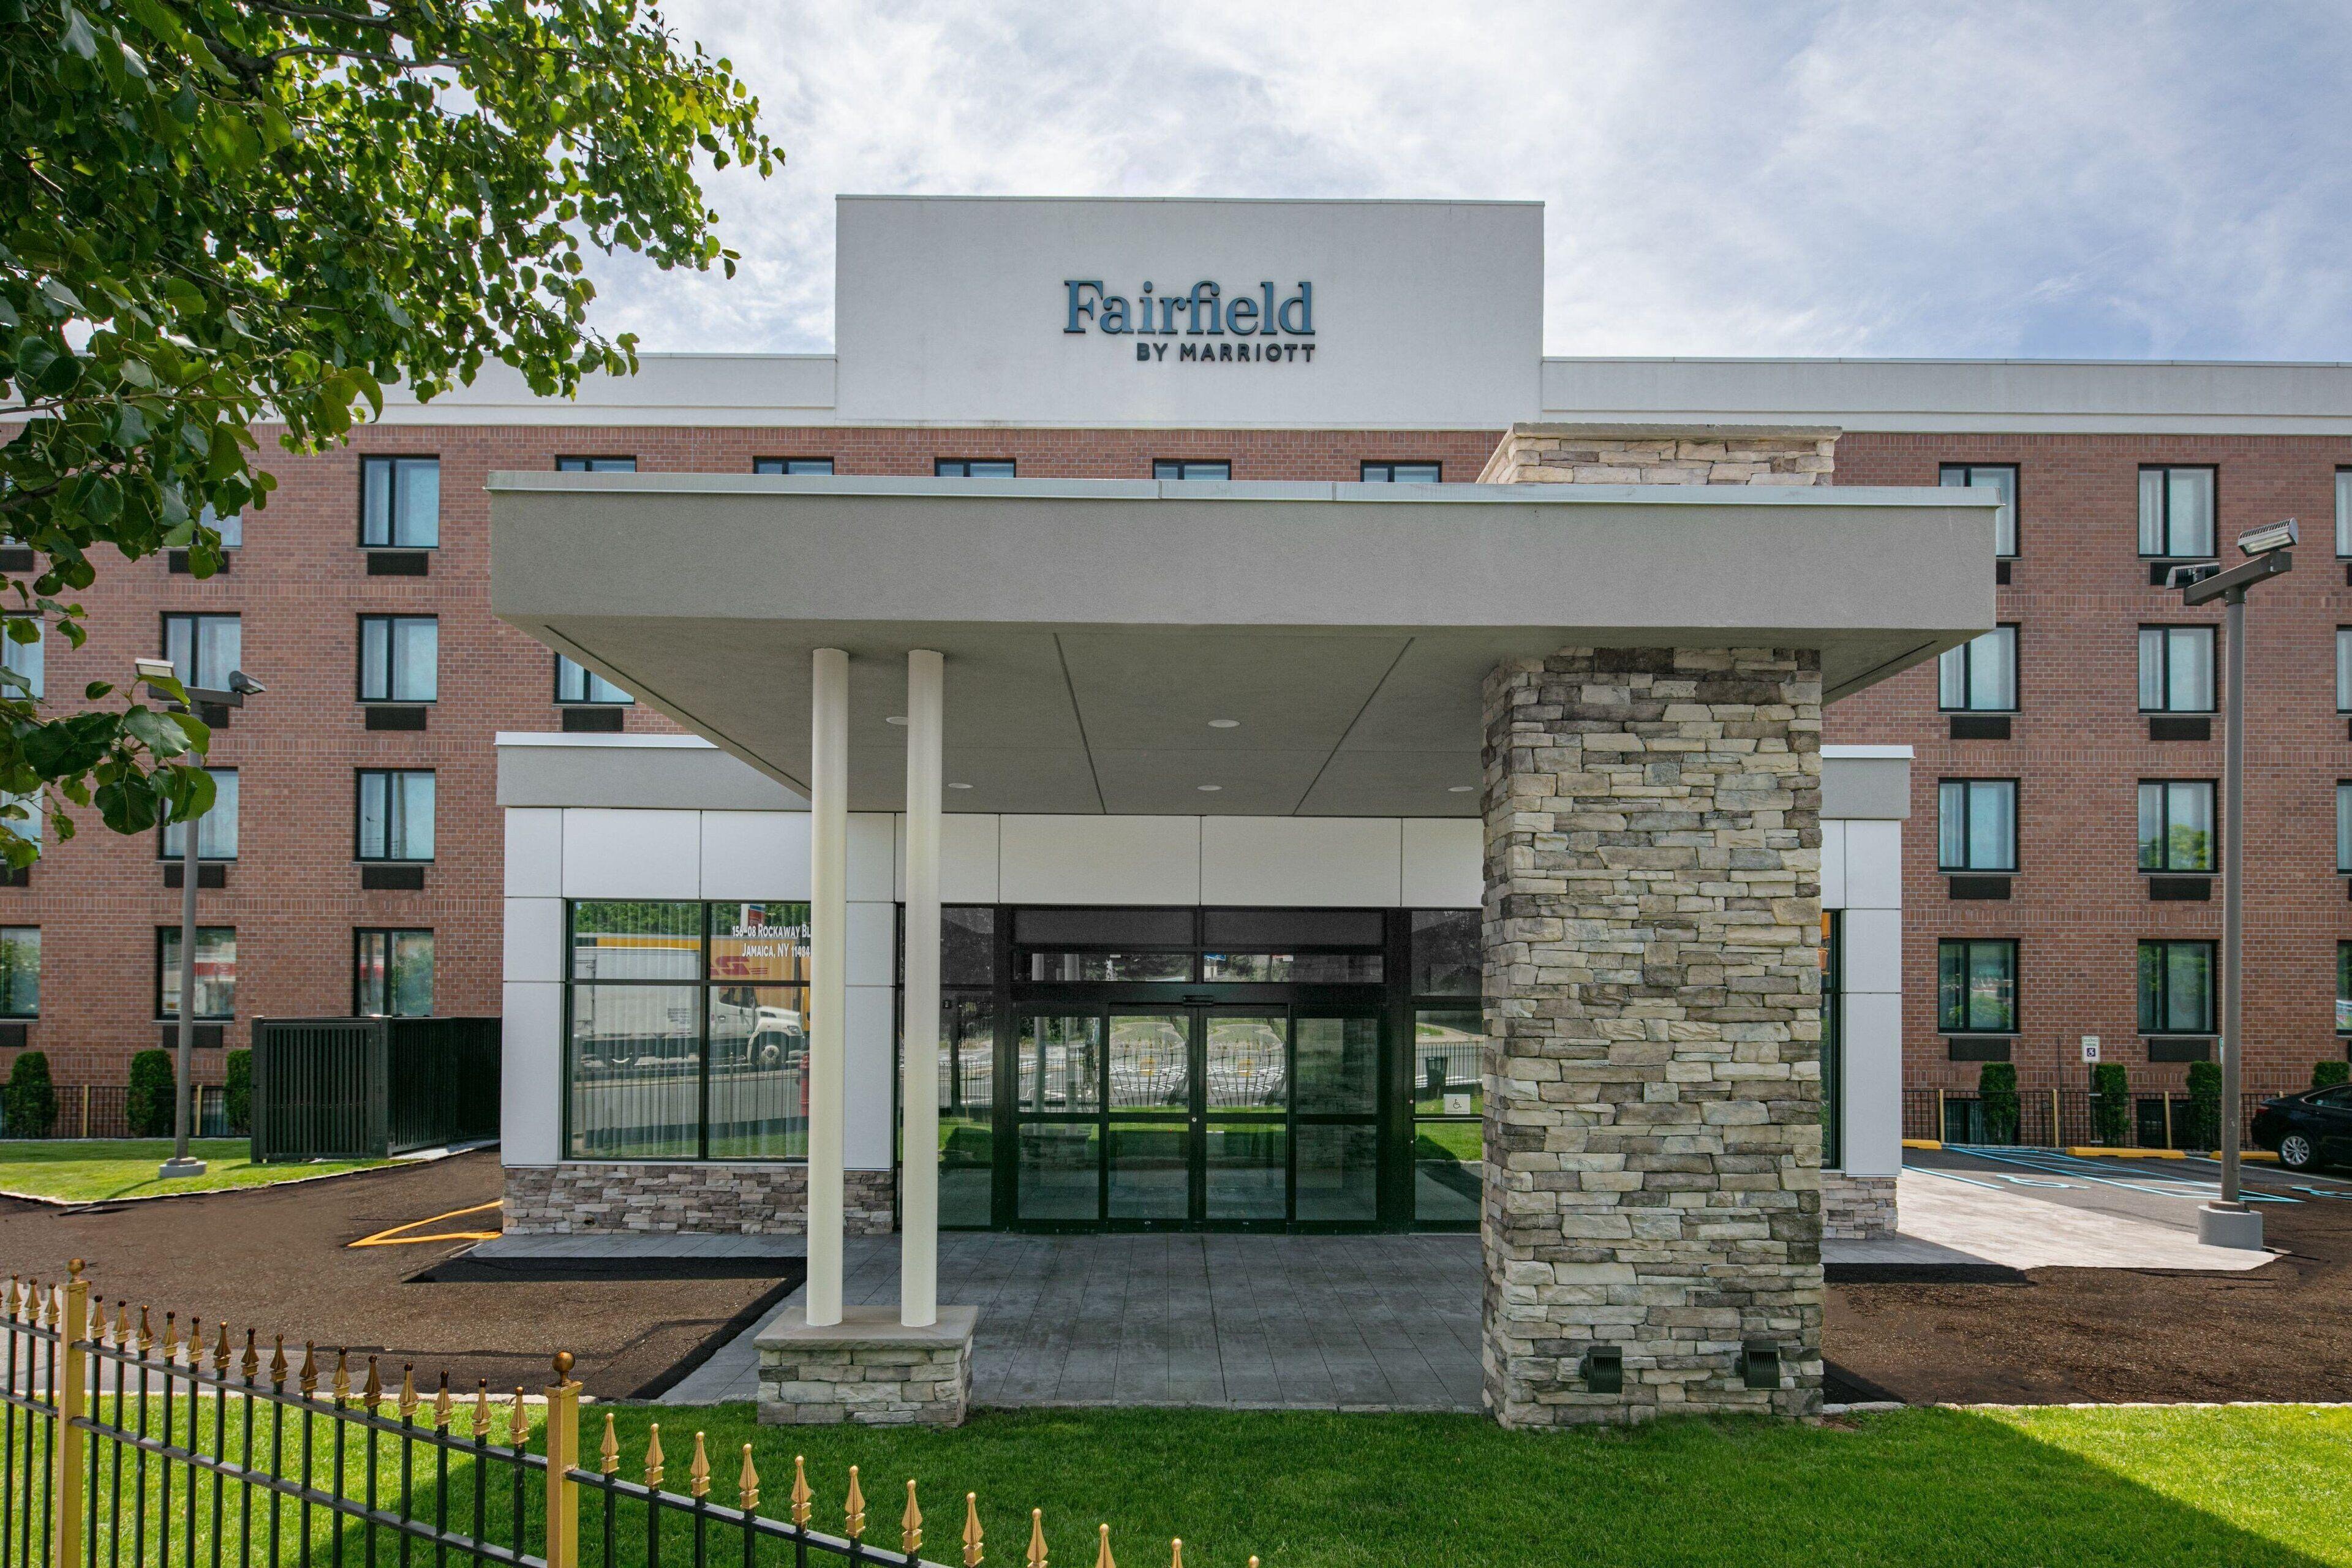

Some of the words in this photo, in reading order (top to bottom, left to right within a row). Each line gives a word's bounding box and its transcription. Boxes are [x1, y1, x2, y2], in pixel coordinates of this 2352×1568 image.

[1063, 280, 1316, 336] Fairfield
[1137, 342, 1168, 362] BY
[1180, 343, 1315, 362] MARRIOTT
[732, 925, 756, 937] 156-08
[777, 943, 789, 957] NY
